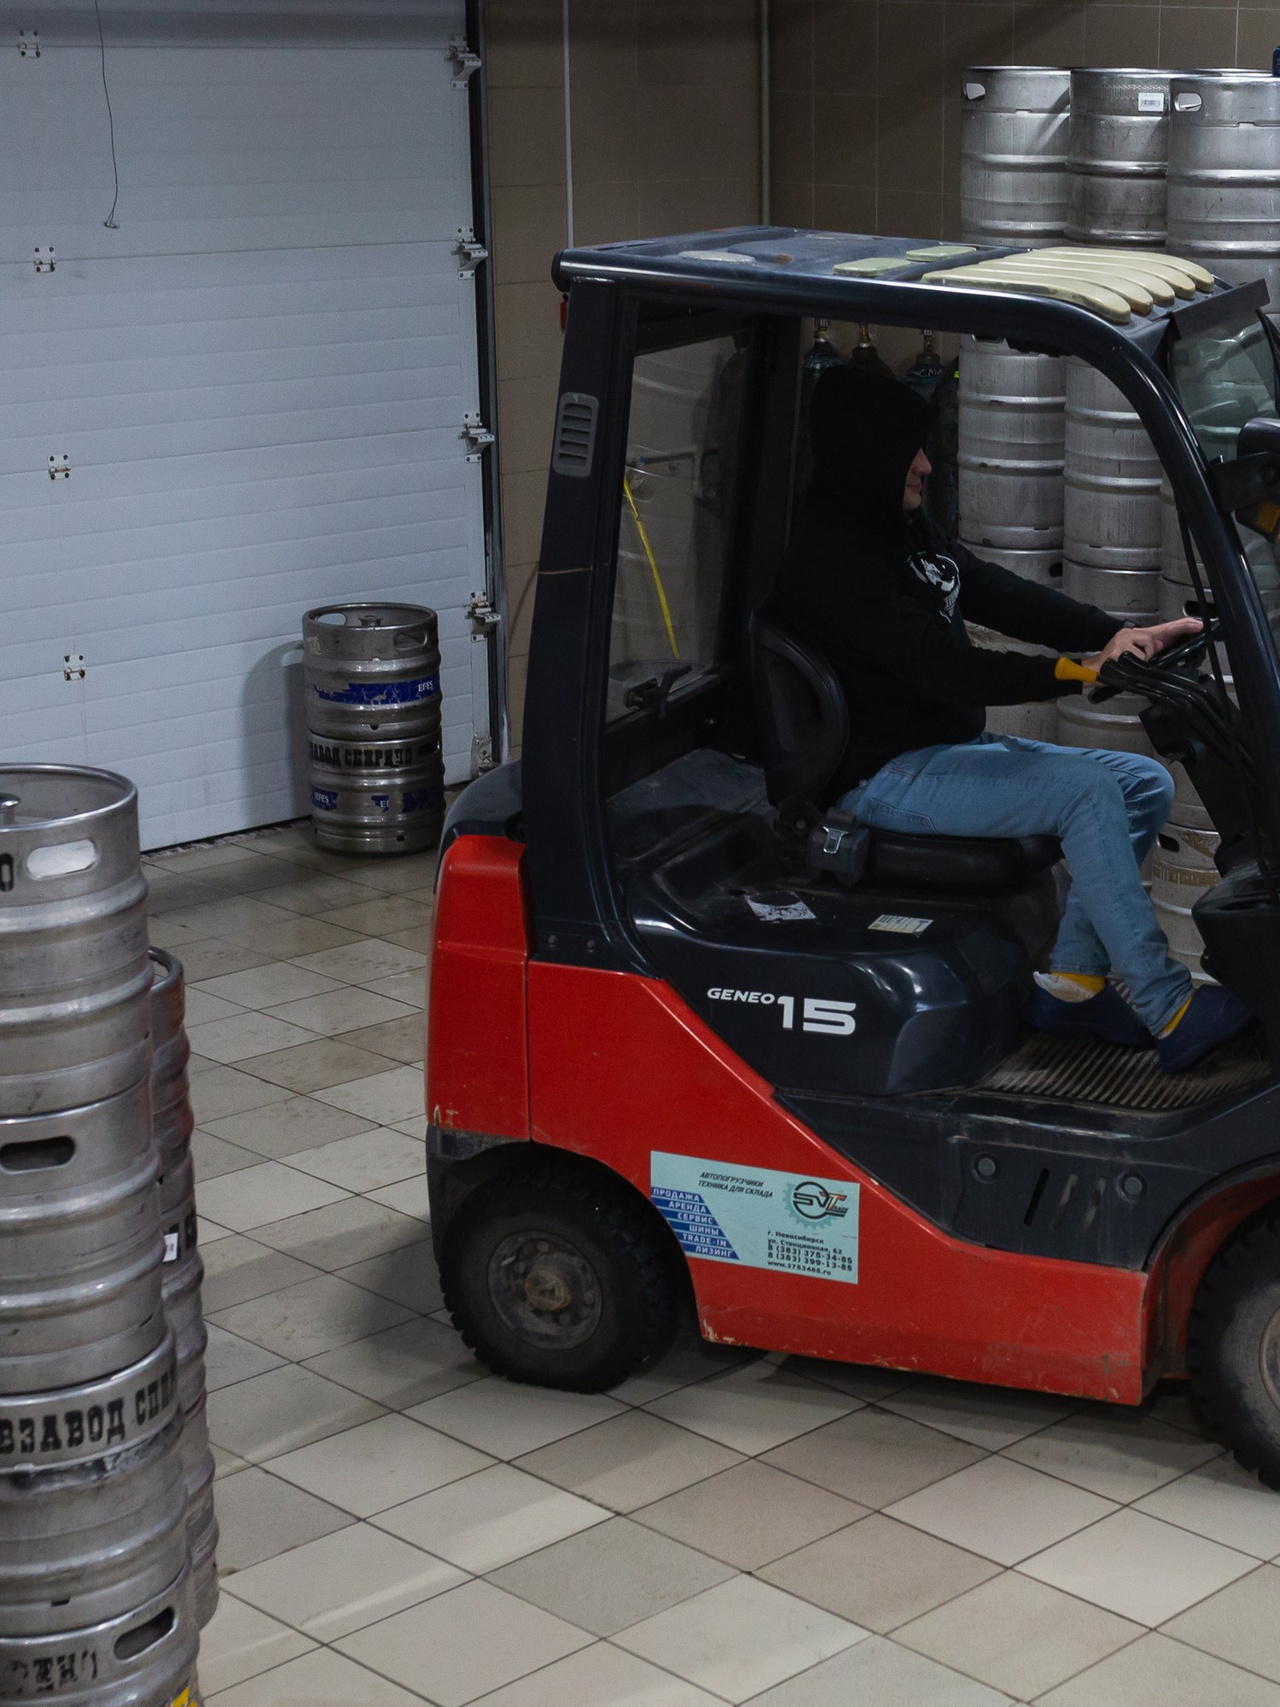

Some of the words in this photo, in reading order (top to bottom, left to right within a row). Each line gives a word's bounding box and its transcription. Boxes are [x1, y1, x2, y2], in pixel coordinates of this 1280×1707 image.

[417, 680, 434, 692] EFES
[707, 987, 775, 1004] GENEO
[778, 995, 856, 1036] 15
[700, 1171, 764, 1187] АВТОПОГРУЗЧИКИ
[653, 1188, 700, 1202] ПРОДАЖА
[698, 1180, 729, 1191] ТЕХНИКА
[729, 1185, 745, 1193] ДЛЯ
[745, 1188, 773, 1198] СКЛАДА
[668, 1201, 707, 1214] АРЕНДА
[677, 1212, 713, 1225] СЕРВИС
[688, 1224, 719, 1236] ШИНЫ
[682, 1233, 727, 1247] TRADE-IN
[775, 1231, 824, 1244] Новосибирск
[695, 1246, 733, 1258] ЛИЗИНГ
[776, 1245, 801, 1255] (383)
[767, 1251, 774, 1259] 8
[776, 1252, 801, 1263] (383)
